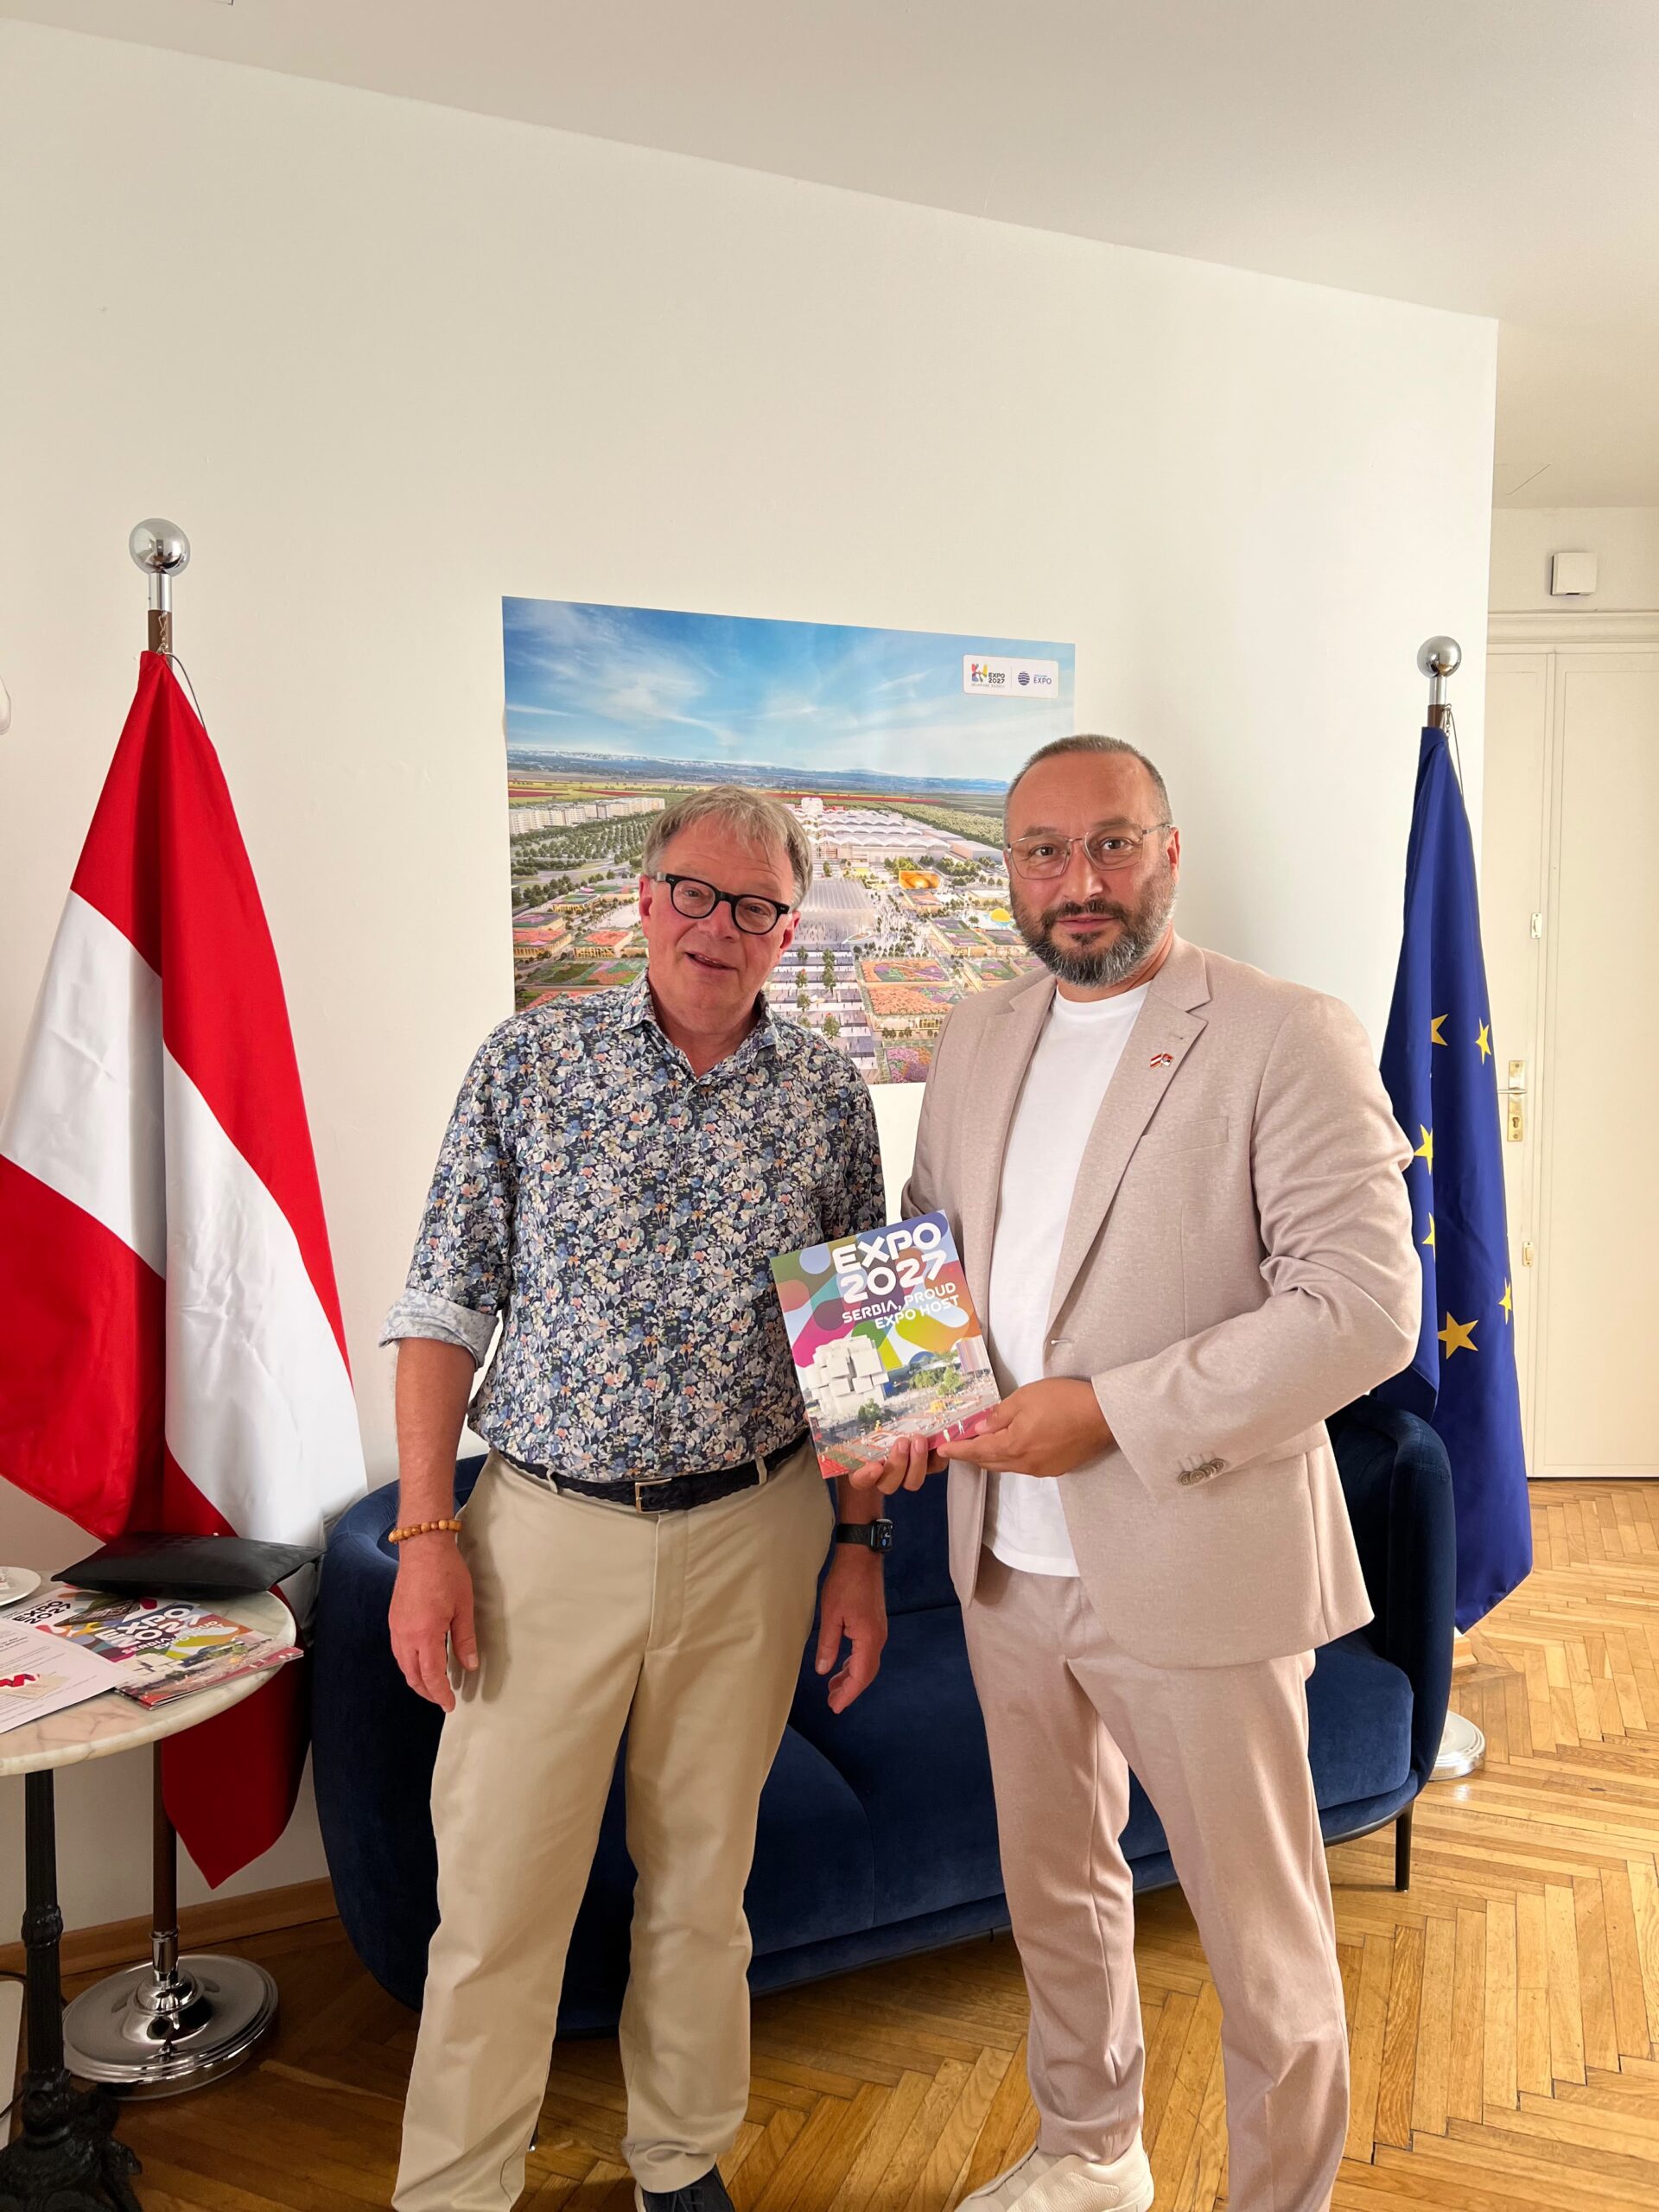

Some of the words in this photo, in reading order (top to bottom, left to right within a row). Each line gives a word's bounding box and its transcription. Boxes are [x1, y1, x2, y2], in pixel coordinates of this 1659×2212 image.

[832, 1222, 941, 1274] EXPO
[841, 1249, 947, 1304] 2027
[842, 1300, 902, 1324] SERBIA,
[904, 1282, 957, 1307] PROUD
[874, 1309, 916, 1330] EXPO
[919, 1294, 959, 1317] HOST
[12, 1601, 63, 1622] EXPO
[24, 1603, 71, 1624] 2027
[94, 1608, 191, 1641] EXPO
[111, 1614, 200, 1649] 2027
